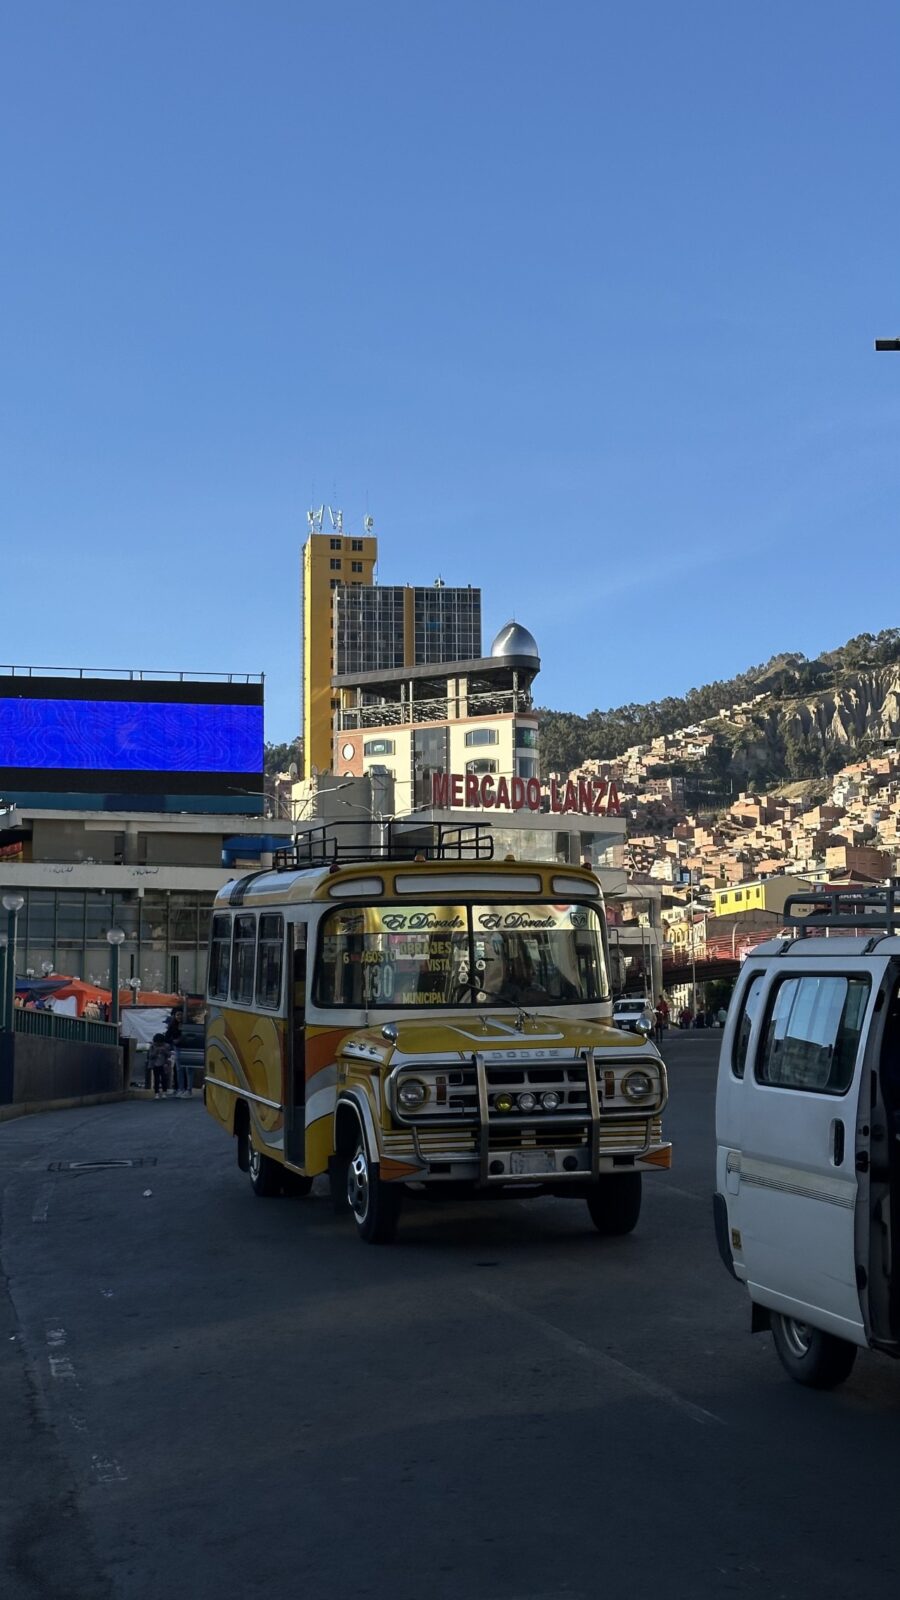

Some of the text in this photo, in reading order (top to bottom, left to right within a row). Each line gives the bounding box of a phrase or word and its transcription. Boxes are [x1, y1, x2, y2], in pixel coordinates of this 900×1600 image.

[432, 772, 622, 816] MERCADO LANZA
[382, 912, 465, 930] El Dorado
[478, 912, 557, 930] El Dorado
[400, 941, 452, 955] OBRAJES
[343, 952, 350, 964] 6
[361, 950, 397, 964] AGOSTO
[427, 959, 451, 972] VISTA
[402, 991, 447, 1004] MUNICIPAL
